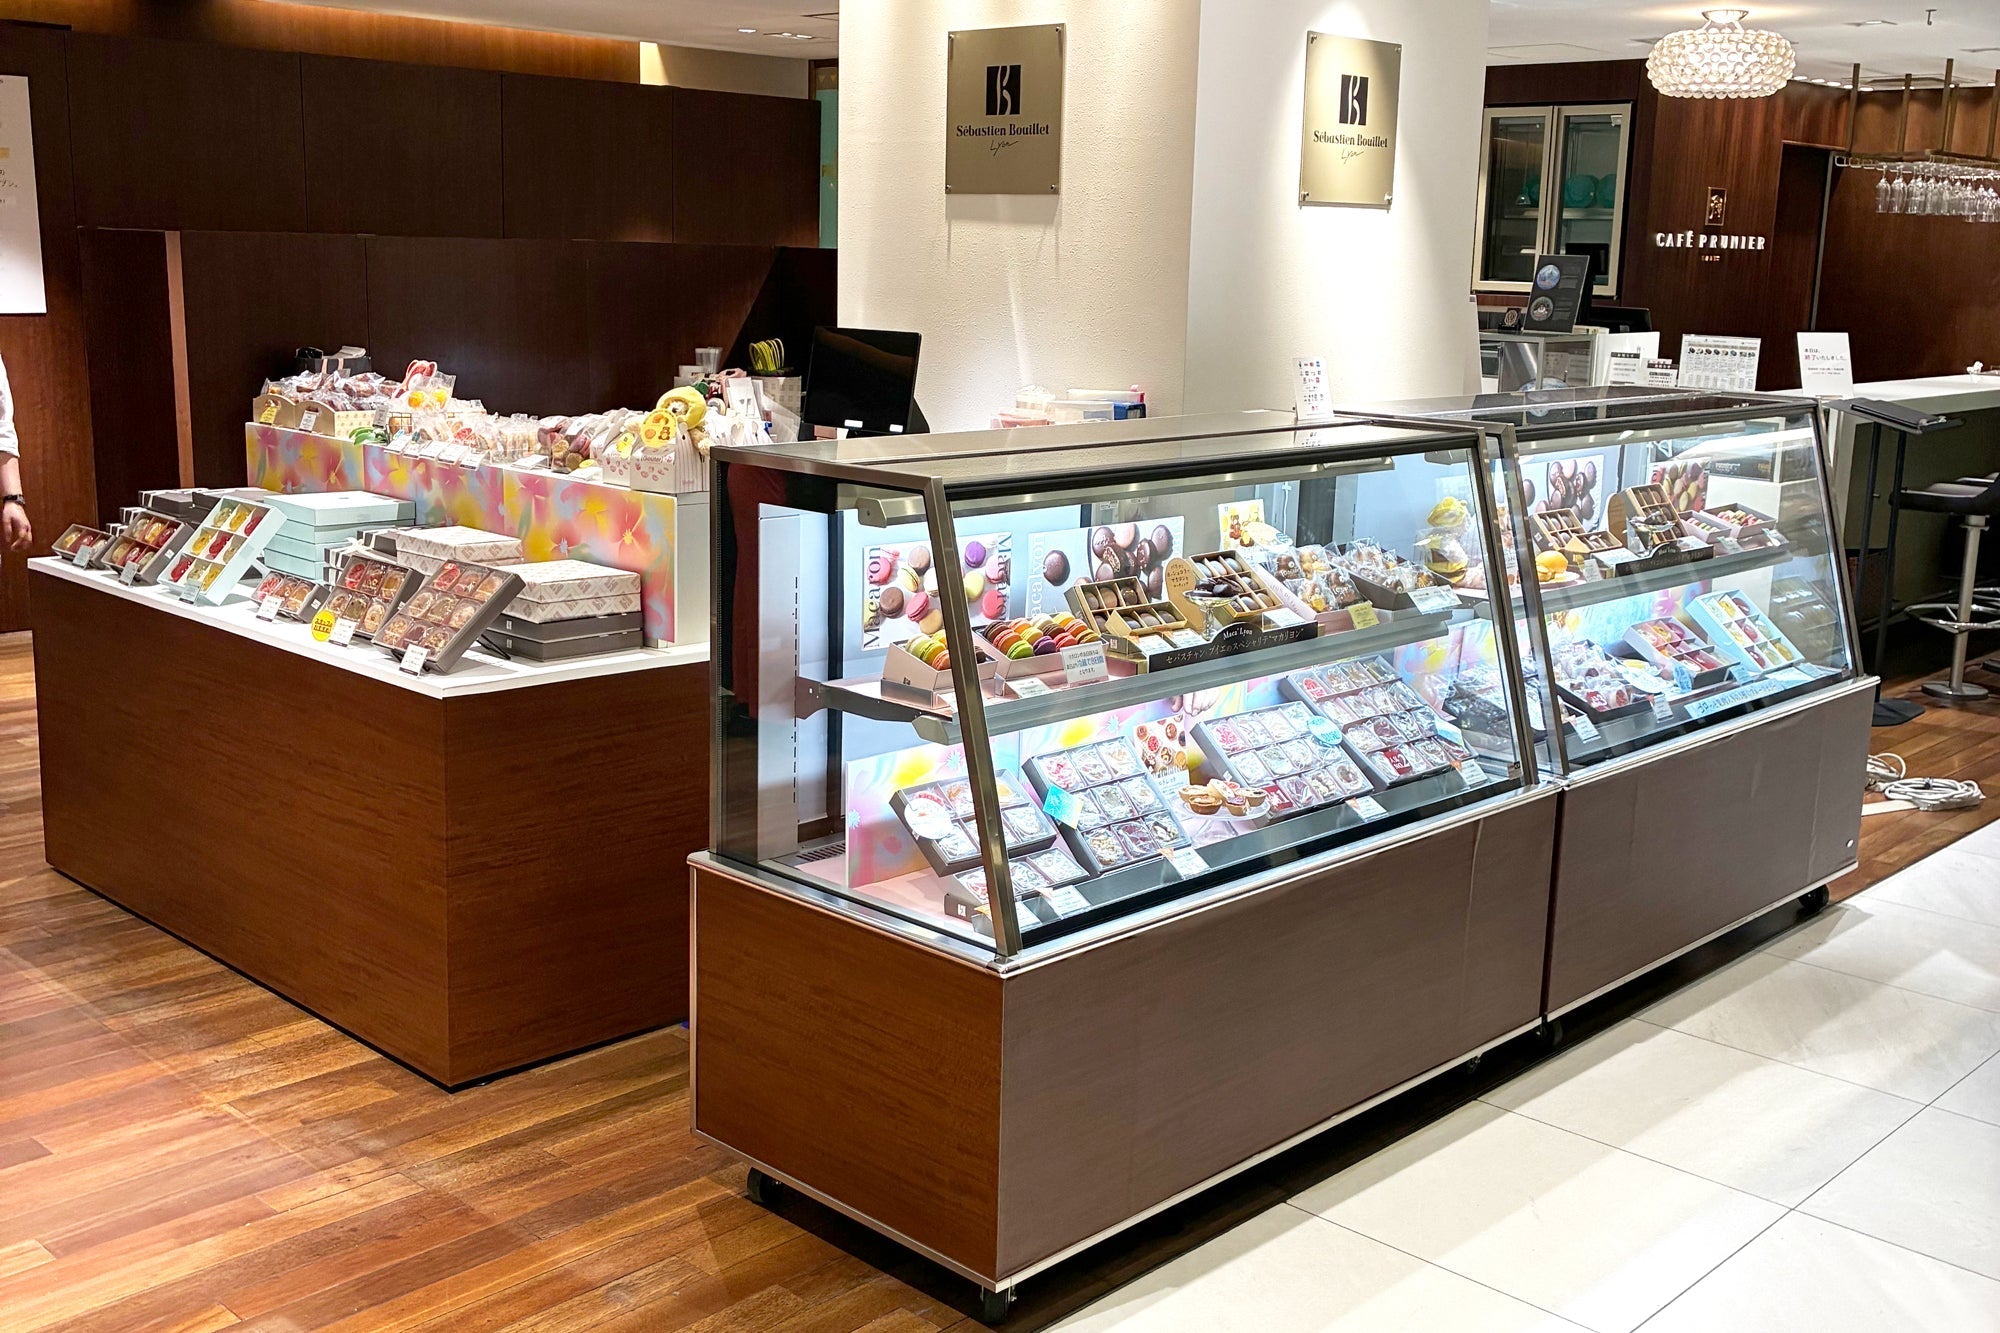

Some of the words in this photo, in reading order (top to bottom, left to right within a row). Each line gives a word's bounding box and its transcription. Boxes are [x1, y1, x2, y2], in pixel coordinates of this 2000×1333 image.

[956, 125, 1006, 137] Sébastien
[1009, 123, 1049, 136] Bouillet
[1313, 130, 1355, 146] Sébastien
[1357, 134, 1388, 148] Bouillet
[1656, 230, 1694, 248] CAFÉ
[1698, 234, 1766, 250] PRUNIER
[863, 547, 881, 648] Macaron
